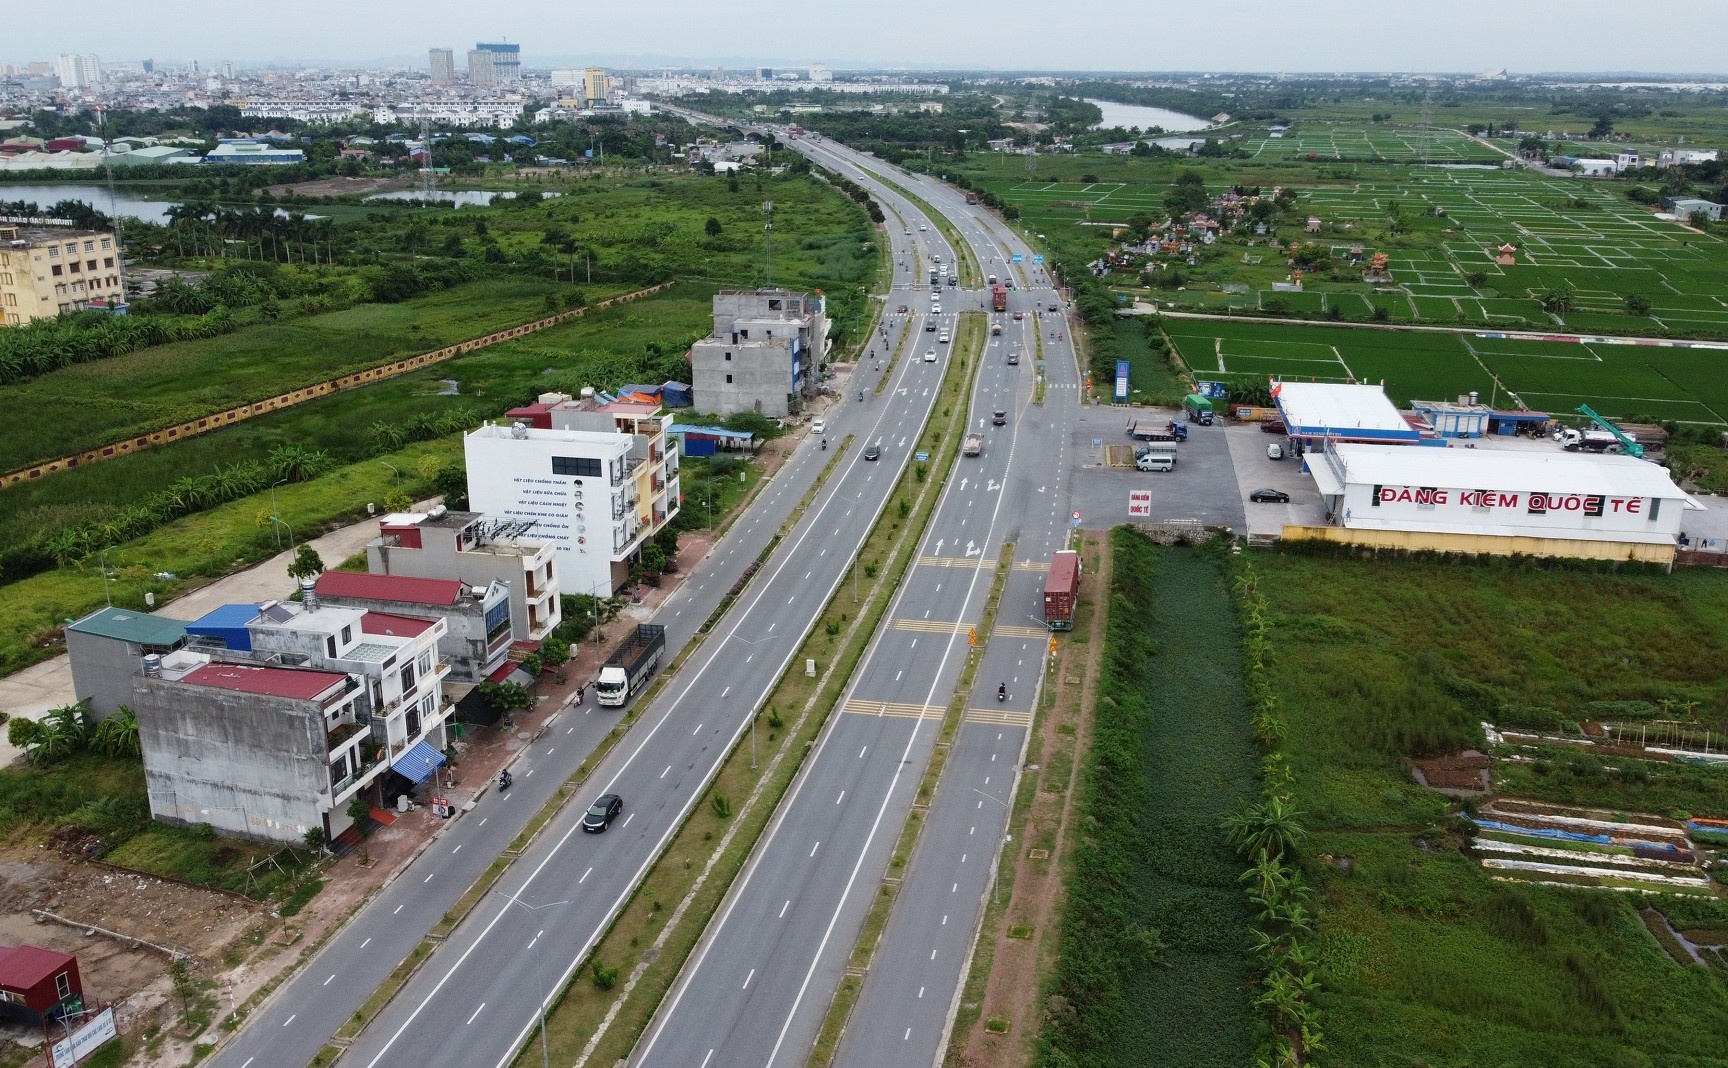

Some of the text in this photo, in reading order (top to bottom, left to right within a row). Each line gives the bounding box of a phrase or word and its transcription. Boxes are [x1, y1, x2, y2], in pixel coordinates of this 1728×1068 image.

[1379, 486, 1644, 514] ĐĂNG KIỂM QUỐC TẾ
